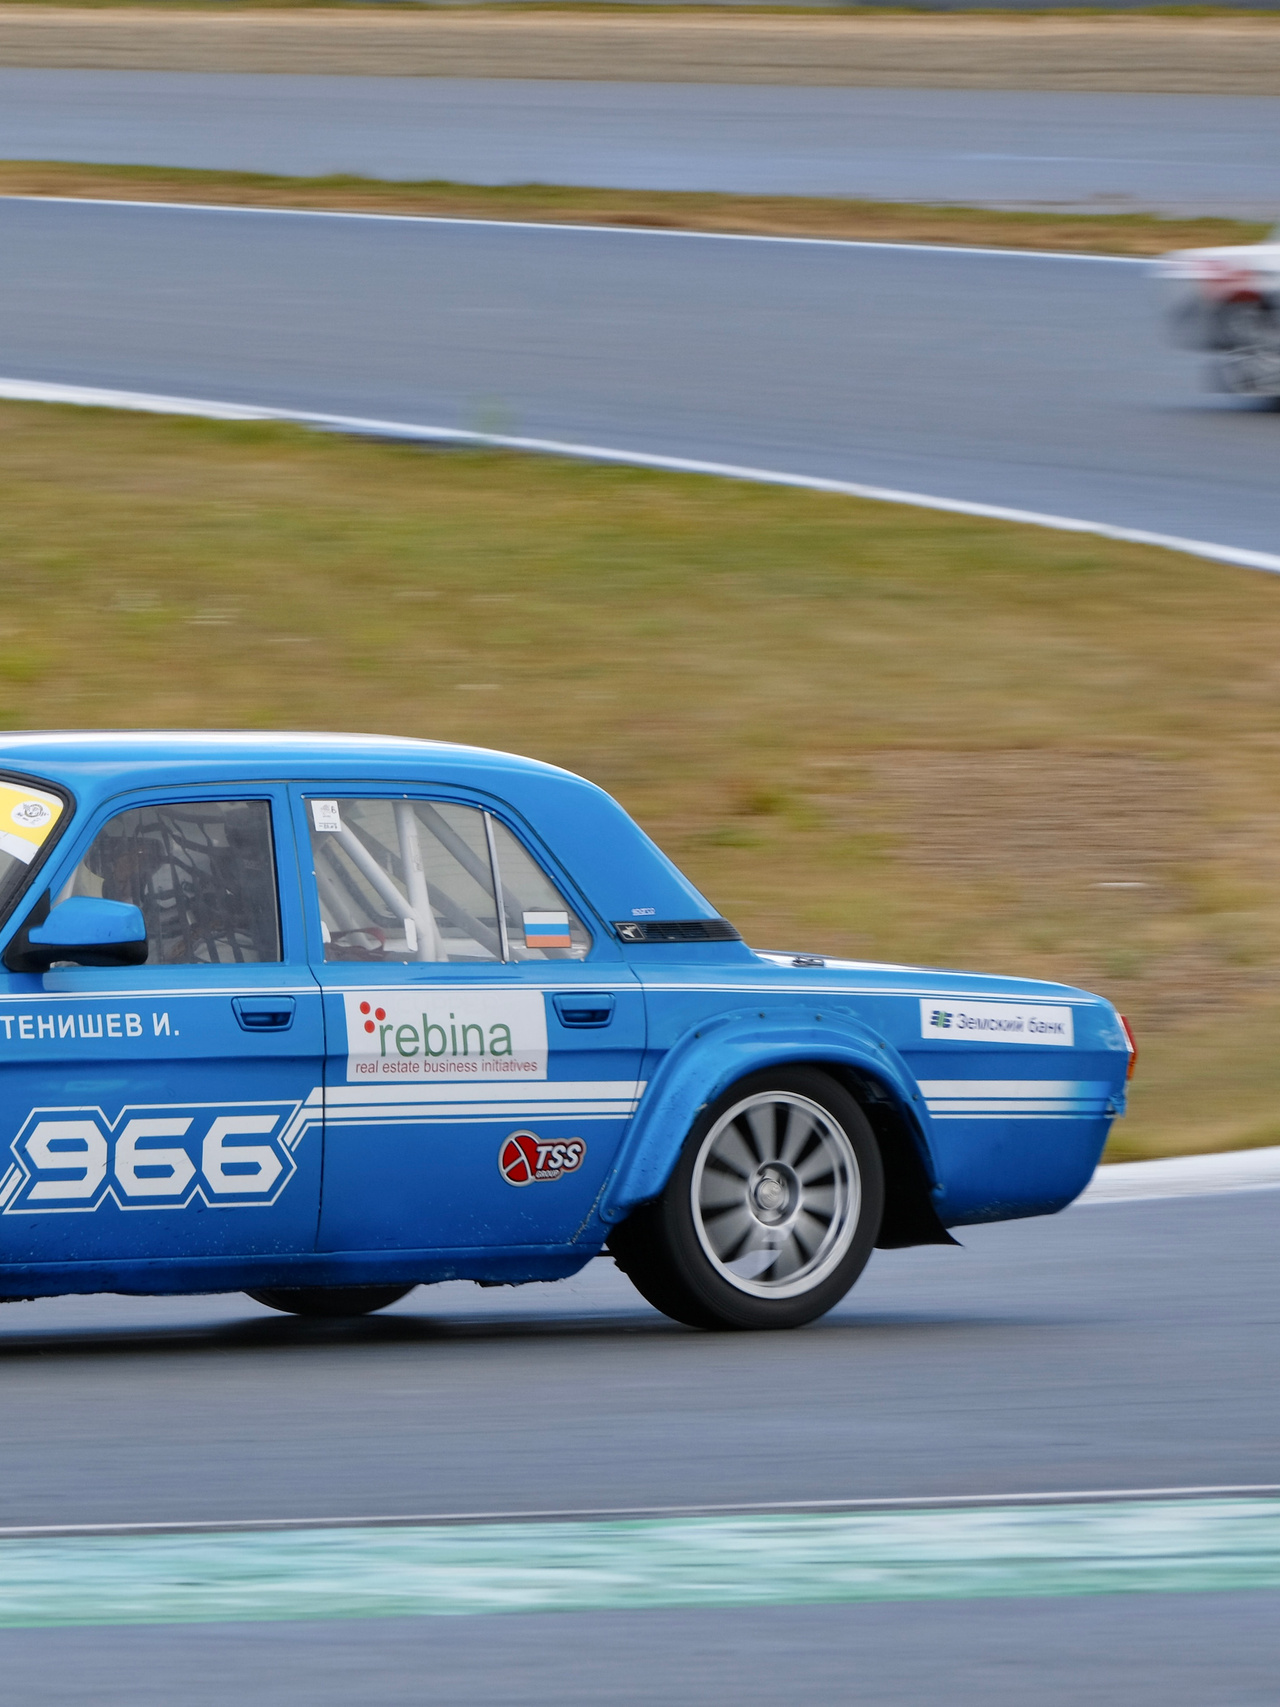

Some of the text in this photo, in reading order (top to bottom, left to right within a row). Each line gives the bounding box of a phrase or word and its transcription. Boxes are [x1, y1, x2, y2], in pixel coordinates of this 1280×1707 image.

[0, 1012, 180, 1039] ТЕНИШЕВ И.
[379, 1012, 513, 1057] rebina
[956, 1012, 1065, 1034] Земский банк
[355, 1058, 538, 1073] real estate business initiatives
[24, 1115, 283, 1200] 966
[536, 1143, 582, 1169] TSS
